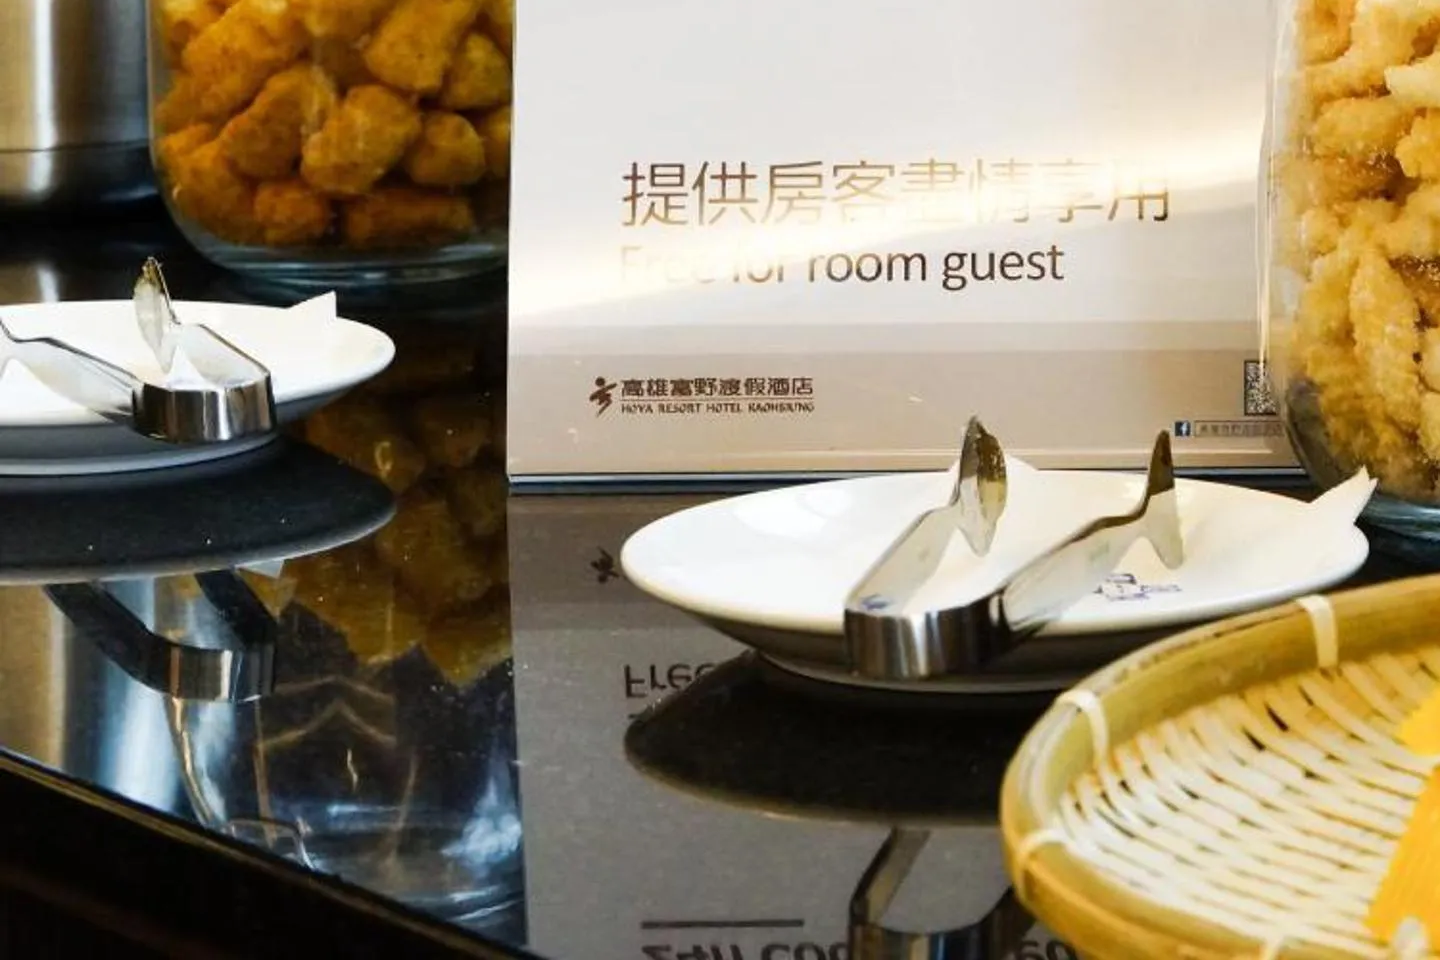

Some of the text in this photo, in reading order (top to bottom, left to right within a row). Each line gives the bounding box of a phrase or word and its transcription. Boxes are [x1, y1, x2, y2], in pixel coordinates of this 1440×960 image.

[808, 251, 927, 283] room
[942, 244, 1065, 291] guest
[621, 401, 815, 414] HOYA RESORT HOTEL KAOHSIUNG
